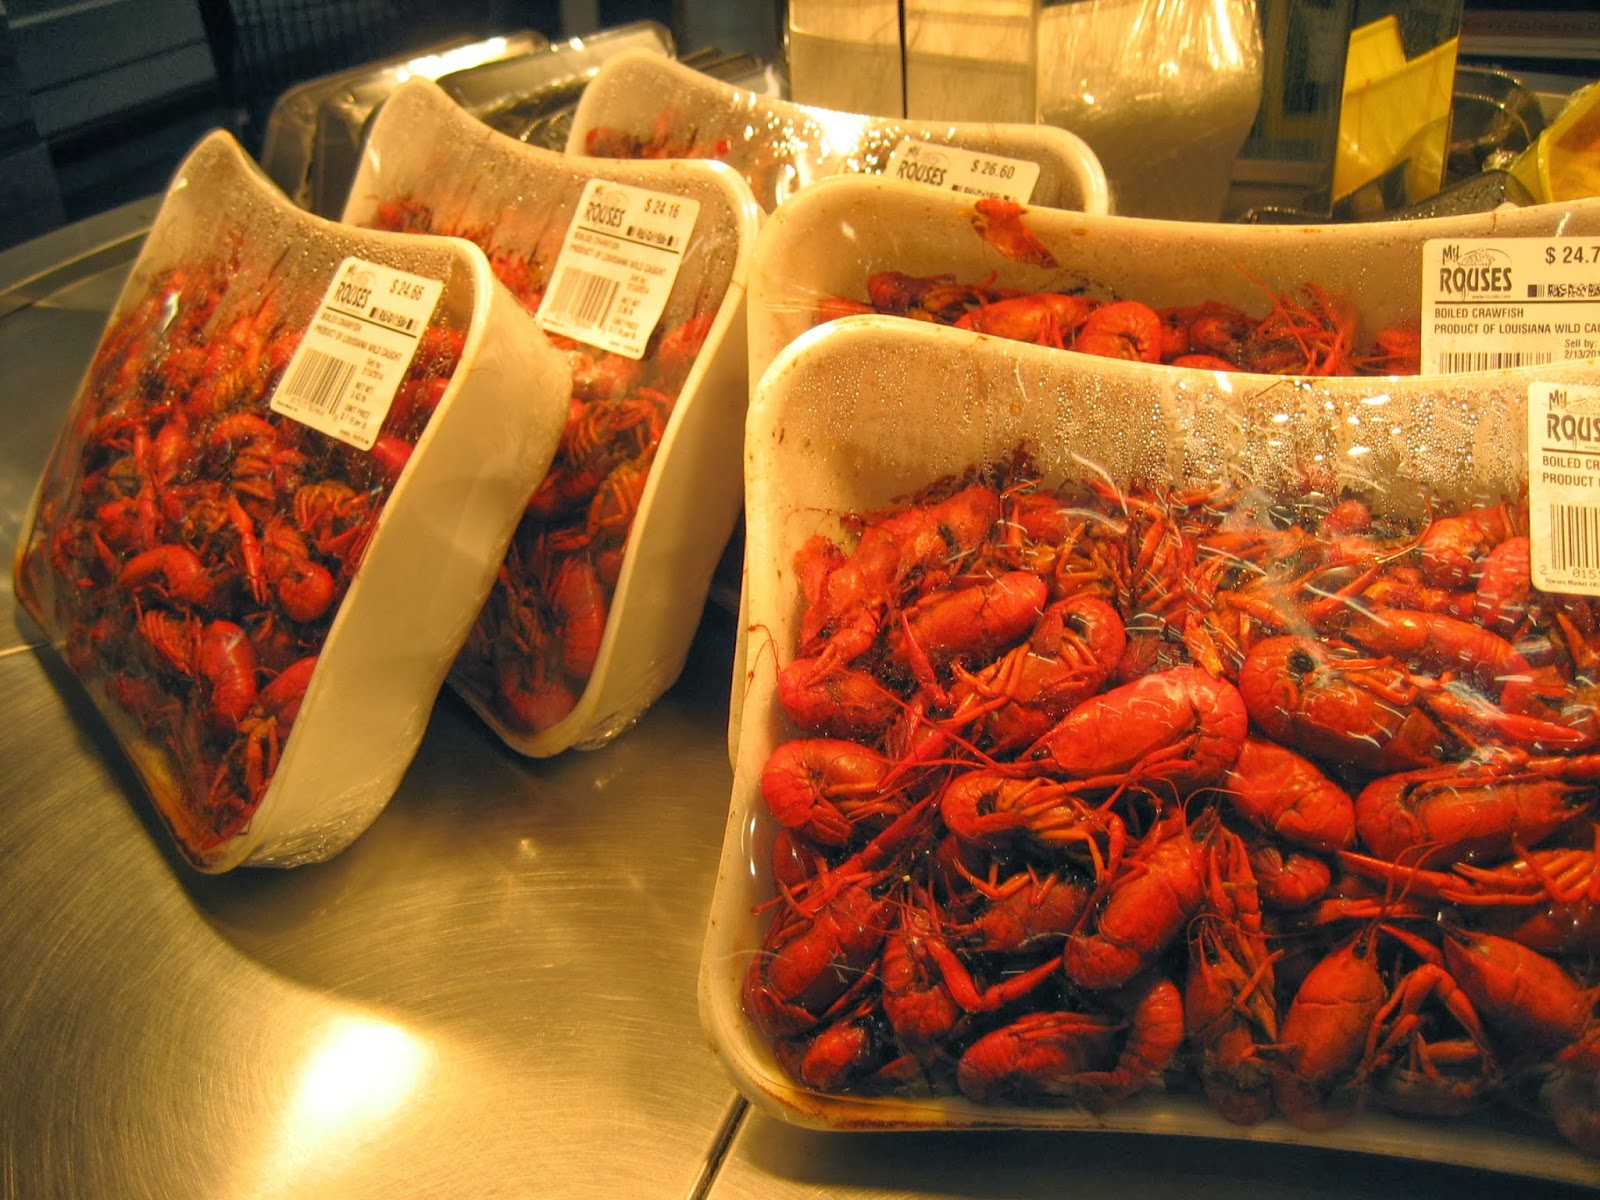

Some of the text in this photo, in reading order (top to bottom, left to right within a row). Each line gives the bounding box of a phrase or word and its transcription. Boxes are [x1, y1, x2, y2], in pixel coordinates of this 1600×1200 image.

[896, 160, 947, 186] ROUSES
[981, 161, 1016, 180] 26.60
[584, 201, 626, 228] ROUSES
[652, 199, 681, 219] 24.16
[1442, 244, 1461, 266] My
[1545, 246, 1556, 264] $
[1439, 267, 1512, 294] ROUSES
[333, 281, 372, 309] ROUSES
[397, 283, 425, 301] 24.66
[1434, 307, 1524, 319] BOILED CRAWFISH
[1434, 323, 1479, 335] PRODUCT
[1483, 323, 1496, 334] OF
[1499, 323, 1551, 335] LOUISIANA
[1554, 322, 1581, 334] WILD
[1564, 338, 1597, 350] Sell by:
[1549, 390, 1567, 411] My
[1542, 456, 1581, 469] BOILED
[1542, 472, 1594, 488] PRODUCT
